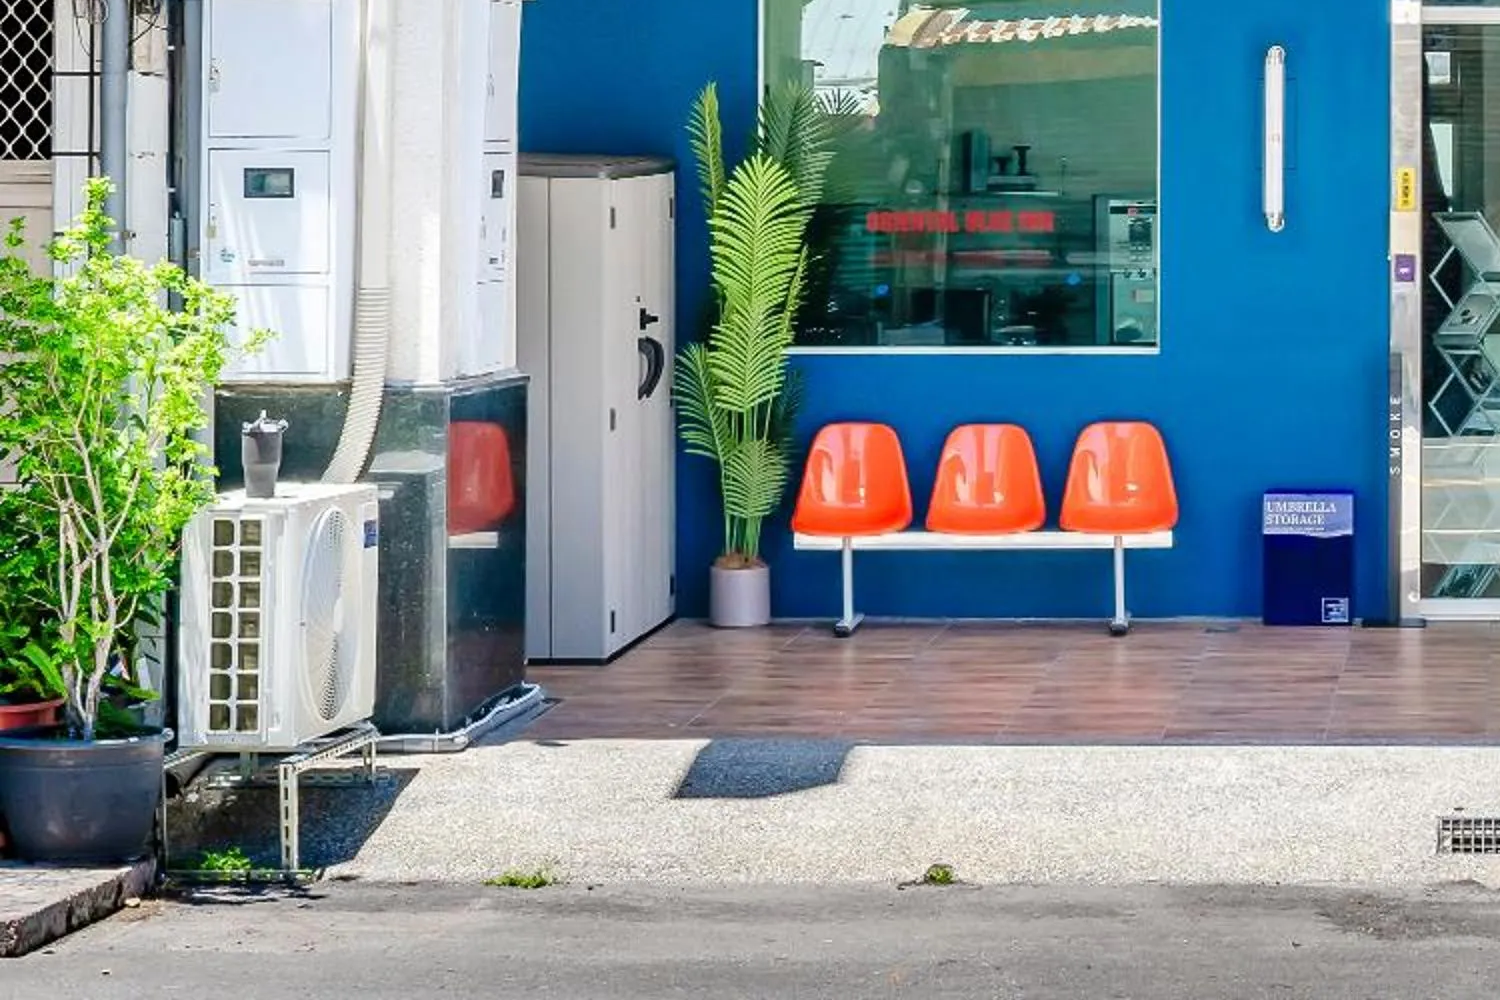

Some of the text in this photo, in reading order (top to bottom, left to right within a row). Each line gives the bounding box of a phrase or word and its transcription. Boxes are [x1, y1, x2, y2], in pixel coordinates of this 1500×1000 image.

[1390, 396, 1401, 475] SMOKE
[1266, 501, 1337, 513] UMBRELLA
[1266, 514, 1325, 525] STORAGE
